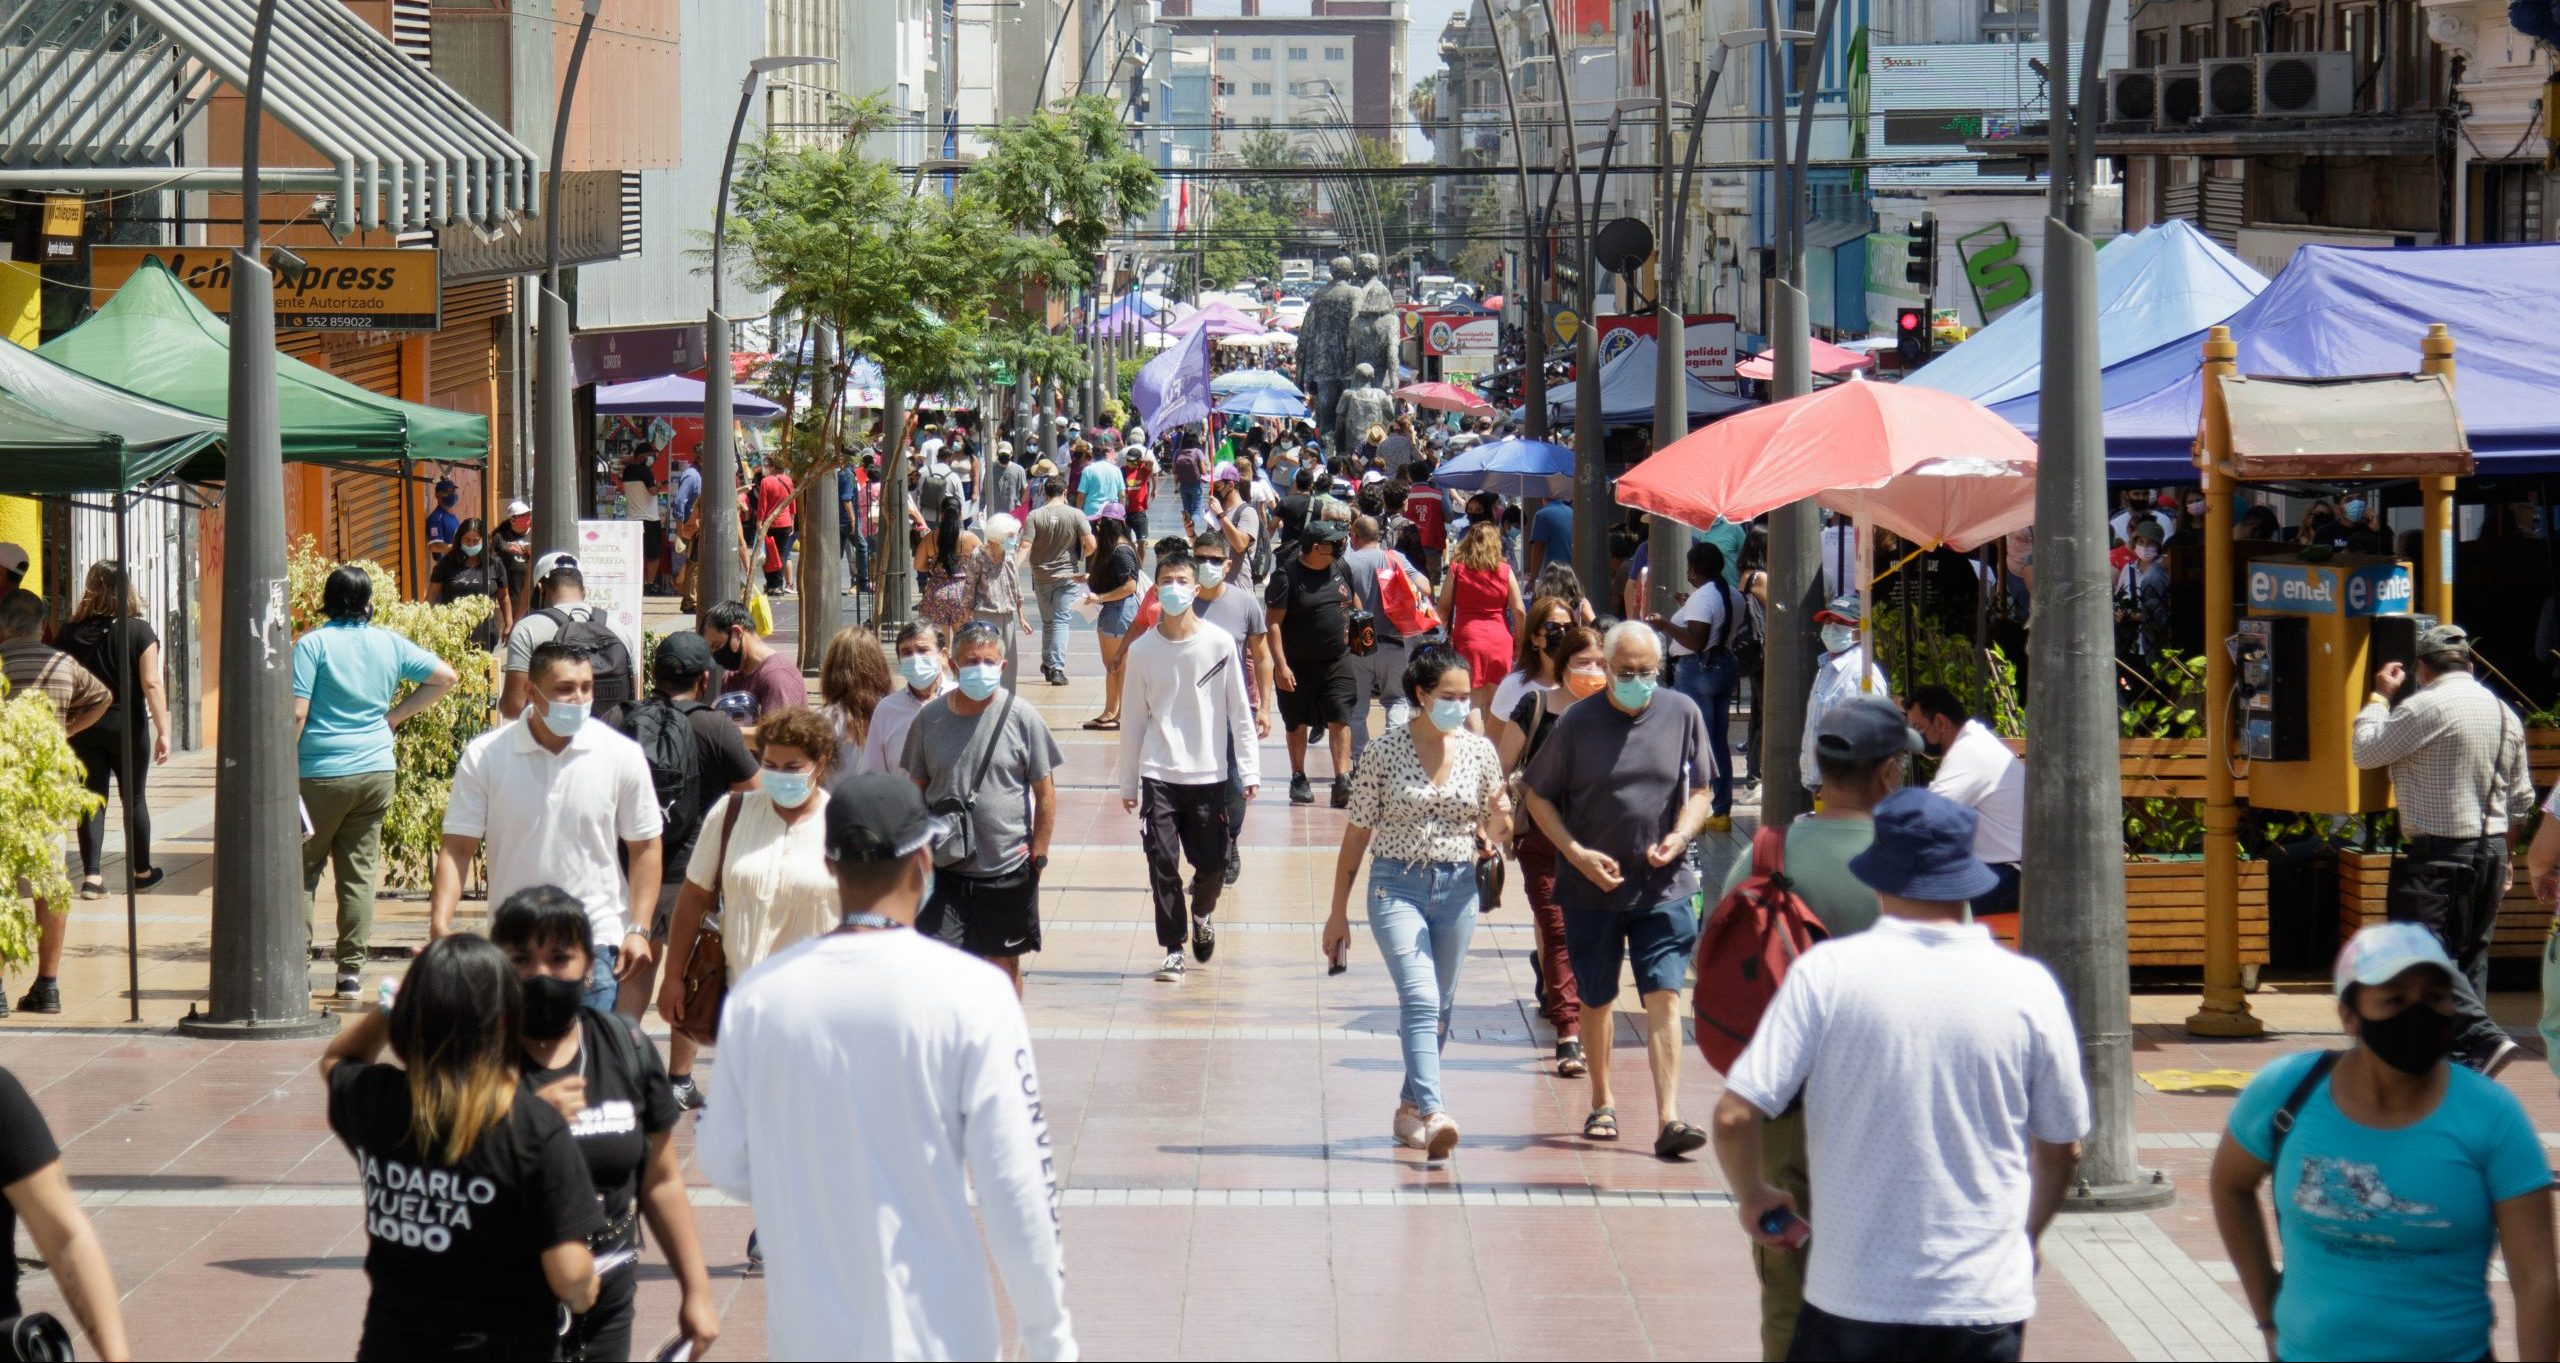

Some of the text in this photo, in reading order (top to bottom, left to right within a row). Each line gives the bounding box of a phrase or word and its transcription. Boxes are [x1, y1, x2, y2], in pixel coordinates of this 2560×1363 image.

[188, 257, 397, 298] chxpress
[275, 296, 384, 309] ente Autorizado
[306, 316, 372, 327] 552 859022
[1685, 347, 1728, 358] palidad
[1685, 358, 1723, 368] agasta
[386, 1161, 497, 1205] DARLO
[367, 1183, 471, 1231] VUELTA
